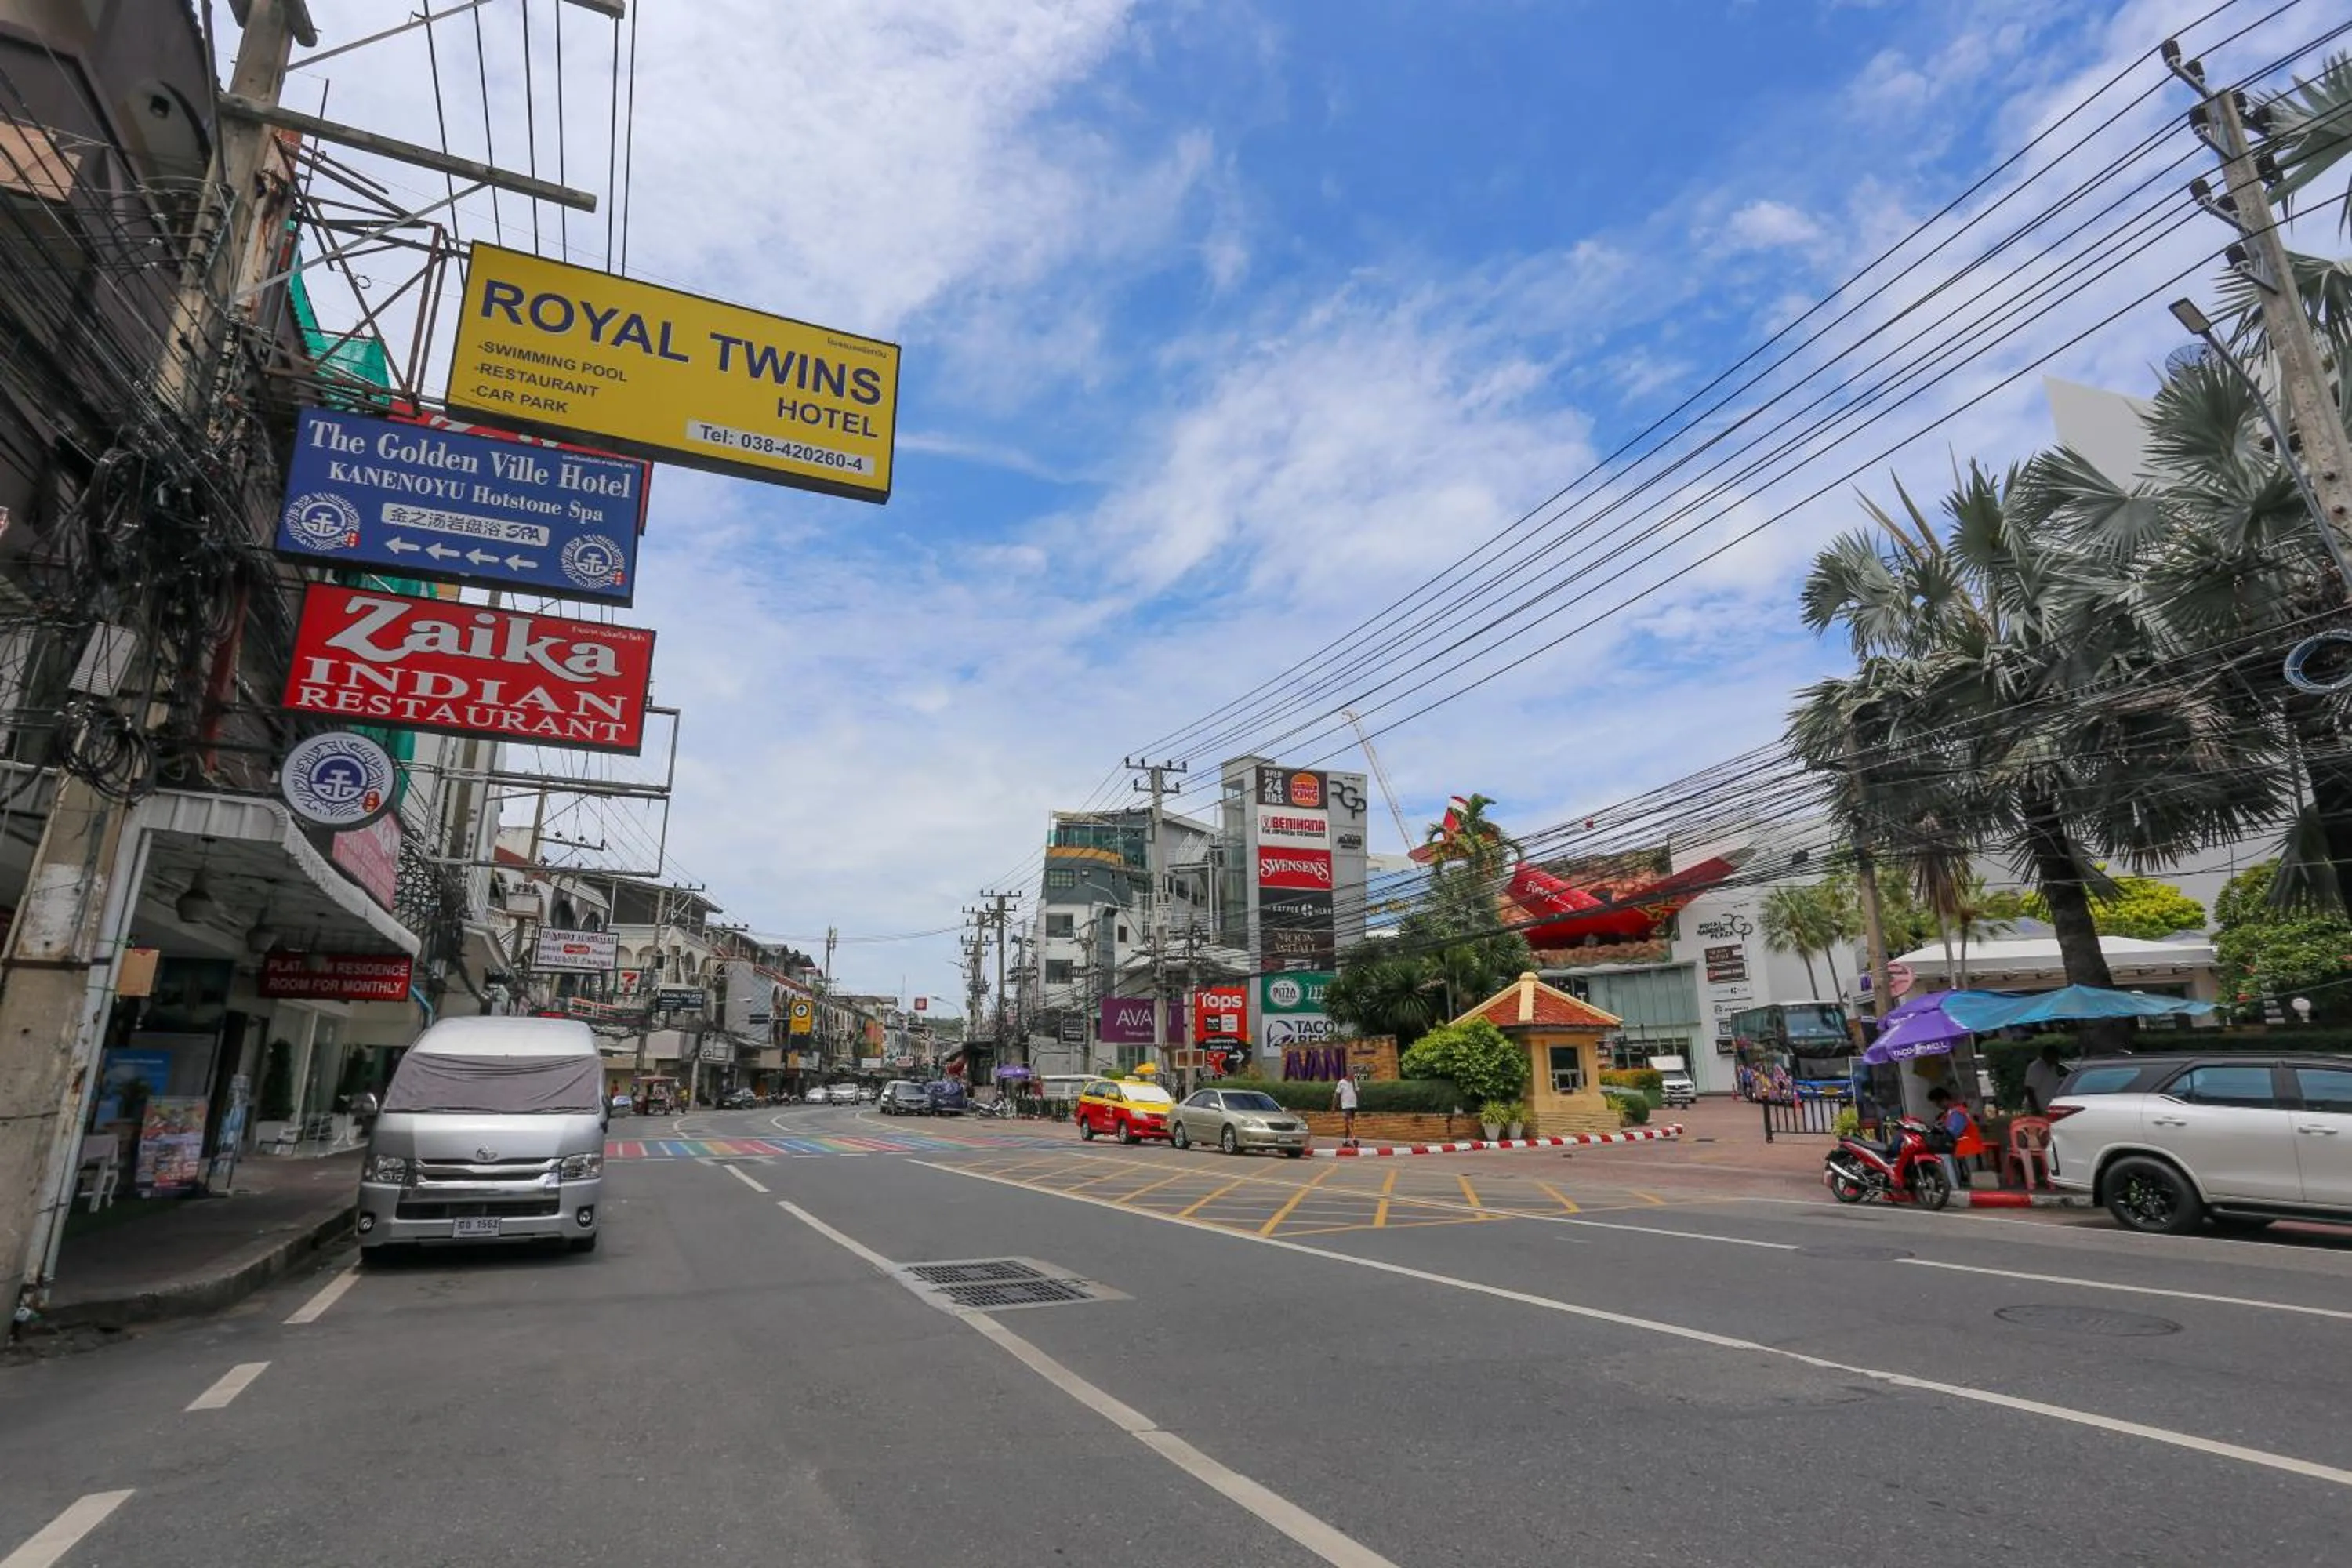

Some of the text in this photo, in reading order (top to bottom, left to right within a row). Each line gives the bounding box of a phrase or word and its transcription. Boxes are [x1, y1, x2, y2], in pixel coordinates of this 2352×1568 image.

[481, 278, 882, 405] ROYAL TWINS
[582, 363, 628, 383] POOL
[520, 394, 568, 413] PARK
[777, 397, 878, 439] HOTEL
[699, 423, 863, 471] Tel: 038-420260-4
[308, 419, 366, 454] The
[377, 432, 478, 474] Golden
[490, 451, 549, 485] Ville
[557, 463, 631, 498] Hotel
[328, 460, 604, 524] KANENOYU Hotstone Spa
[506, 524, 541, 543] SPA
[325, 596, 623, 683] Zaika
[300, 656, 627, 720] INDIAN
[296, 685, 626, 743] RESTAURANT
[1264, 778, 1283, 793] 24
[1293, 789, 1319, 800] KING
[1265, 793, 1283, 804] HRS
[1272, 816, 1326, 832] BENIHANA
[1260, 858, 1329, 880] SWENSEN'S
[336, 962, 408, 976] RESIDENCE
[268, 979, 401, 993] ROOM FOR MONTHLY
[1198, 991, 1243, 1012] Tops
[1295, 1020, 1336, 1033] TACO
[1283, 1047, 1347, 1081] AVANI
